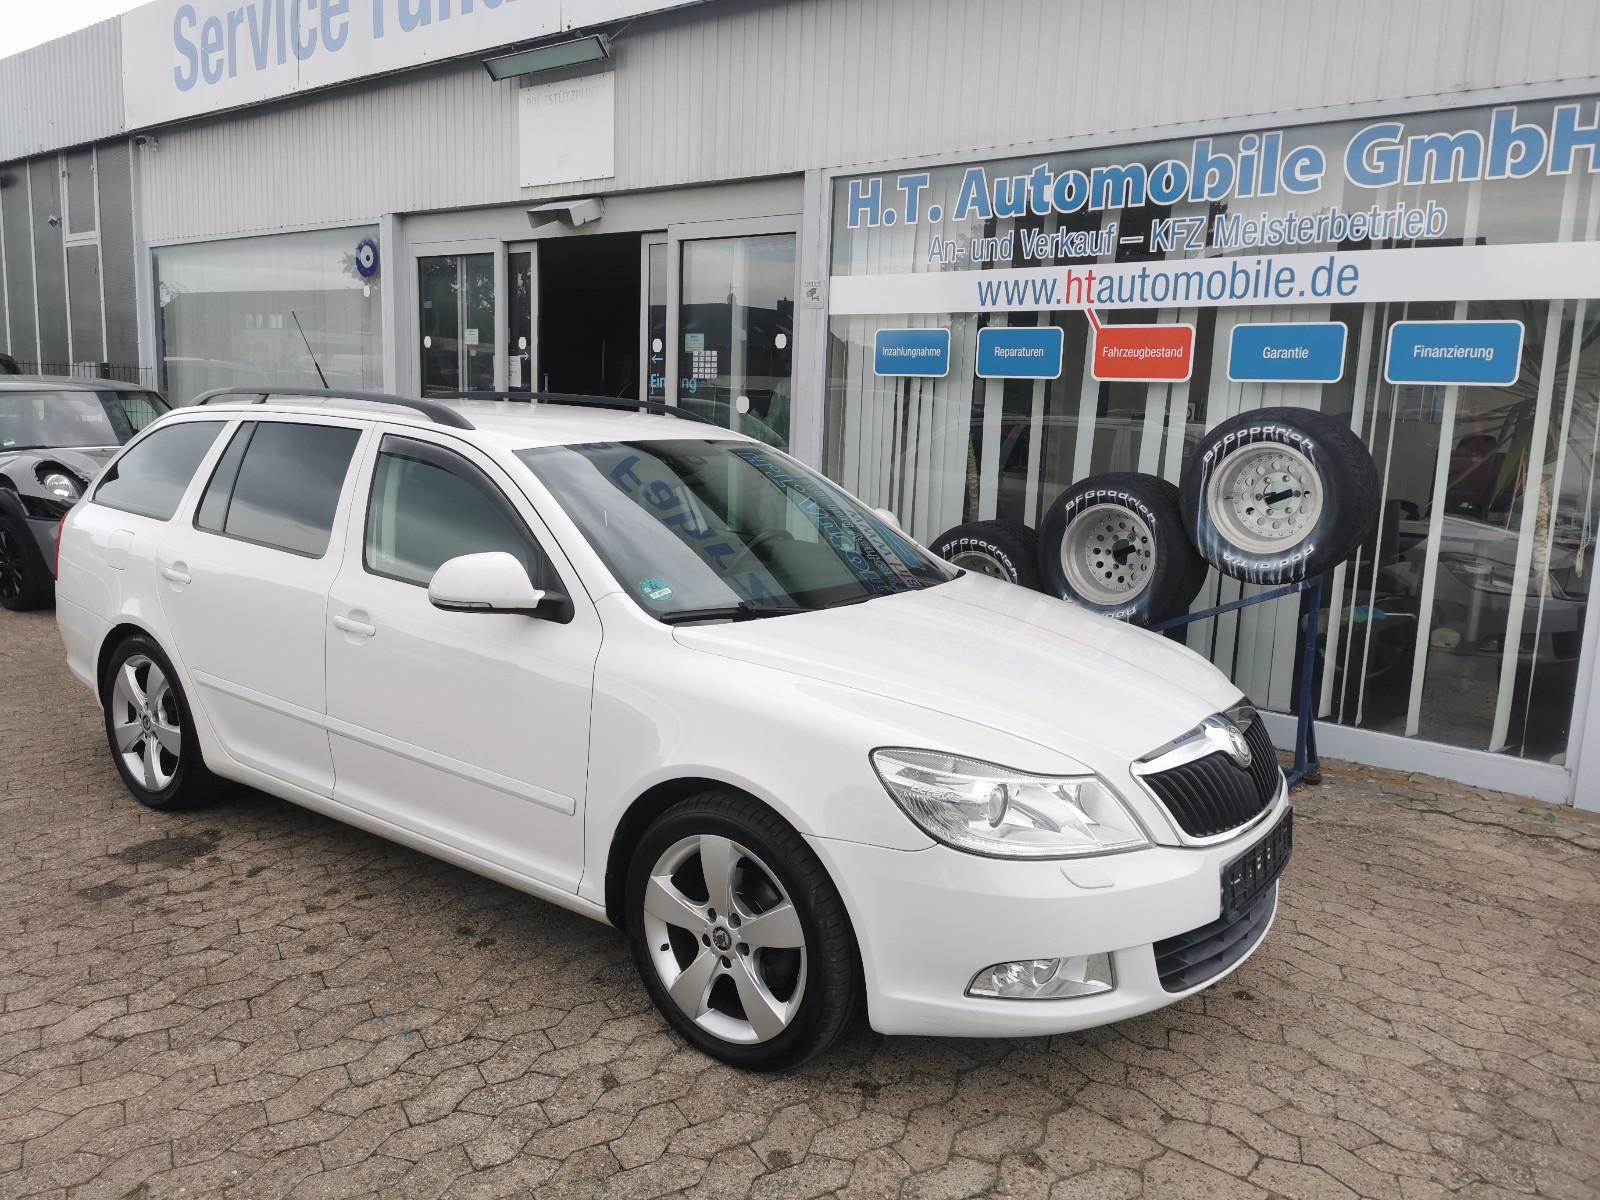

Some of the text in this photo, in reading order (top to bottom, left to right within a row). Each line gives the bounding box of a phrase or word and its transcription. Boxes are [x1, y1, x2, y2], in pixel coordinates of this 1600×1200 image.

[173, 0, 349, 92] Service
[847, 100, 1600, 229] H.T. Automobile GmbH
[928, 235, 965, 264] An-
[971, 230, 1014, 262] und
[1020, 222, 1117, 260] Verkauf
[1149, 216, 1206, 252] KFZ
[1213, 200, 1448, 249] Meisterbetrieb
[977, 256, 1359, 306] www.htautomobile.de
[882, 346, 942, 359] Inzahlungnahme
[994, 346, 1044, 359] Reparaturen
[1102, 345, 1183, 359] Fahrzeugbestand
[1262, 346, 1309, 360] Garantie
[1413, 344, 1494, 361] Finanzierung
[1203, 425, 1315, 463] BFGoodrich
[1065, 490, 1156, 522] BFGoodrich
[942, 538, 1018, 577] BFGoodrich
